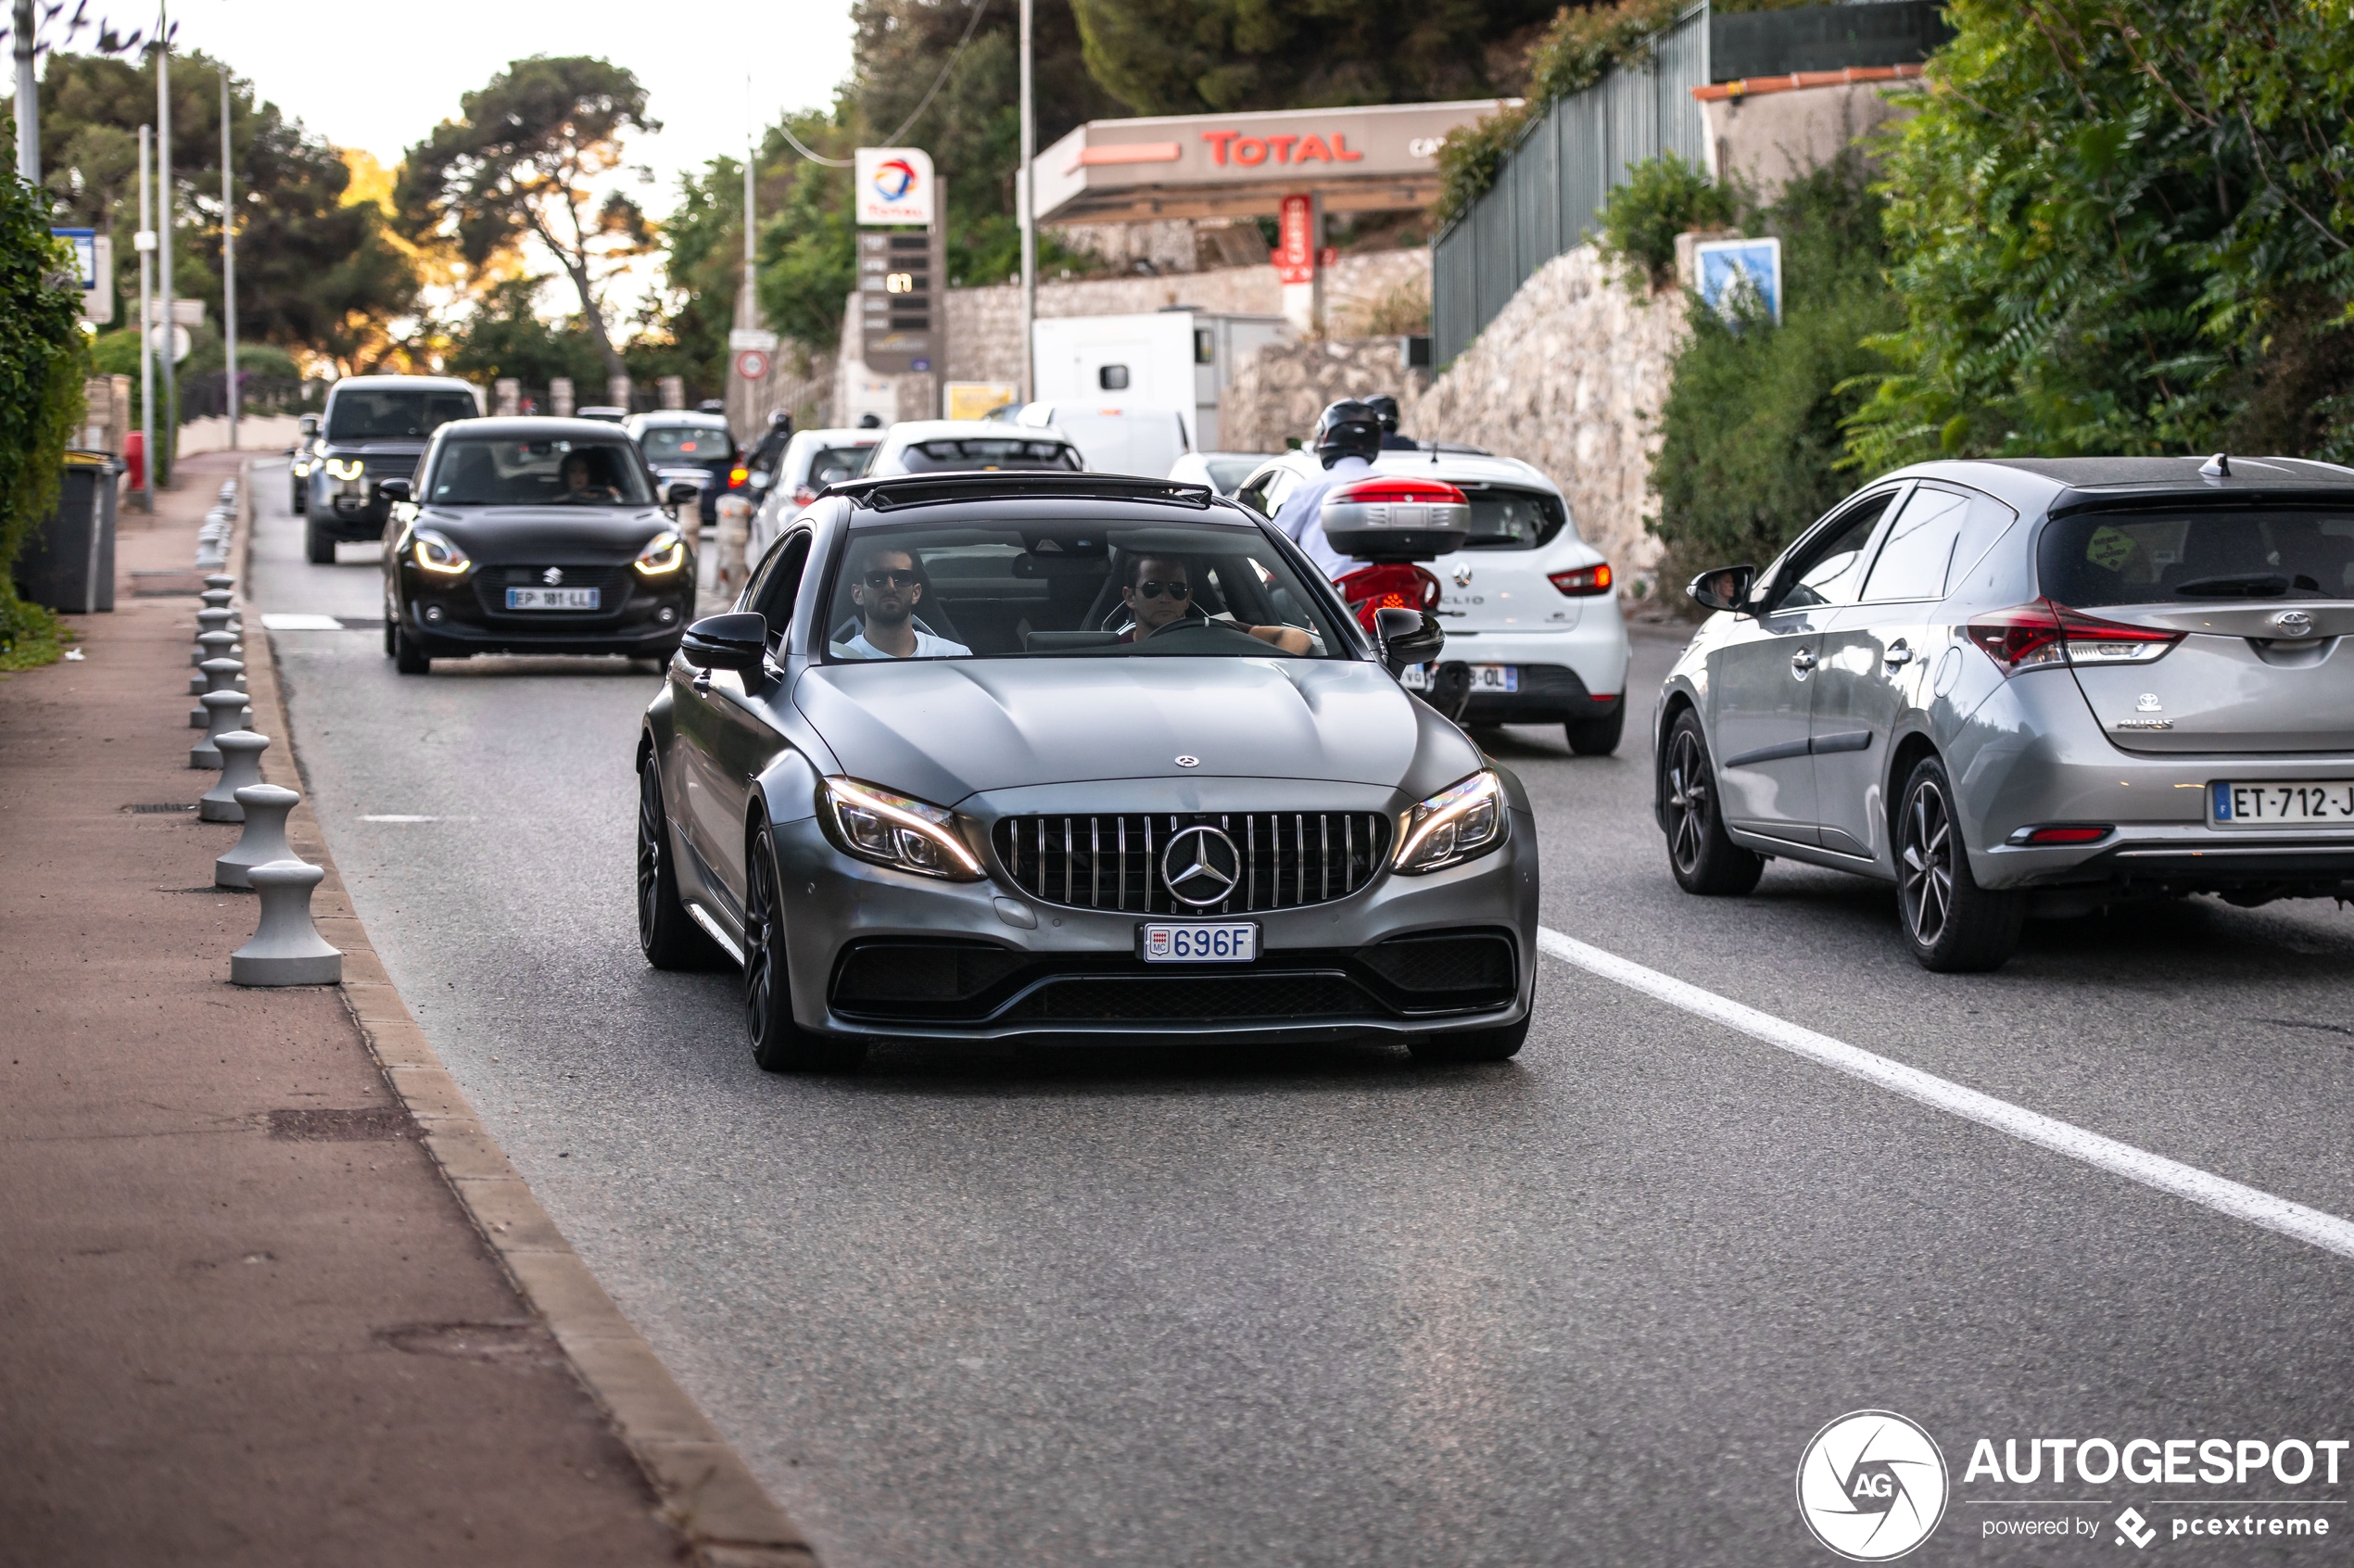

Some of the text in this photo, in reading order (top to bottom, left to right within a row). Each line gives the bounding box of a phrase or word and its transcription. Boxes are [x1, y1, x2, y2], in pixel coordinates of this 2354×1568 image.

[1201, 130, 1362, 167] TOTAL
[1441, 595, 1485, 605] CLIO
[2117, 718, 2174, 729] AURIS
[2234, 787, 2354, 817] ET-712-J
[1153, 929, 1249, 956] MC 696F
